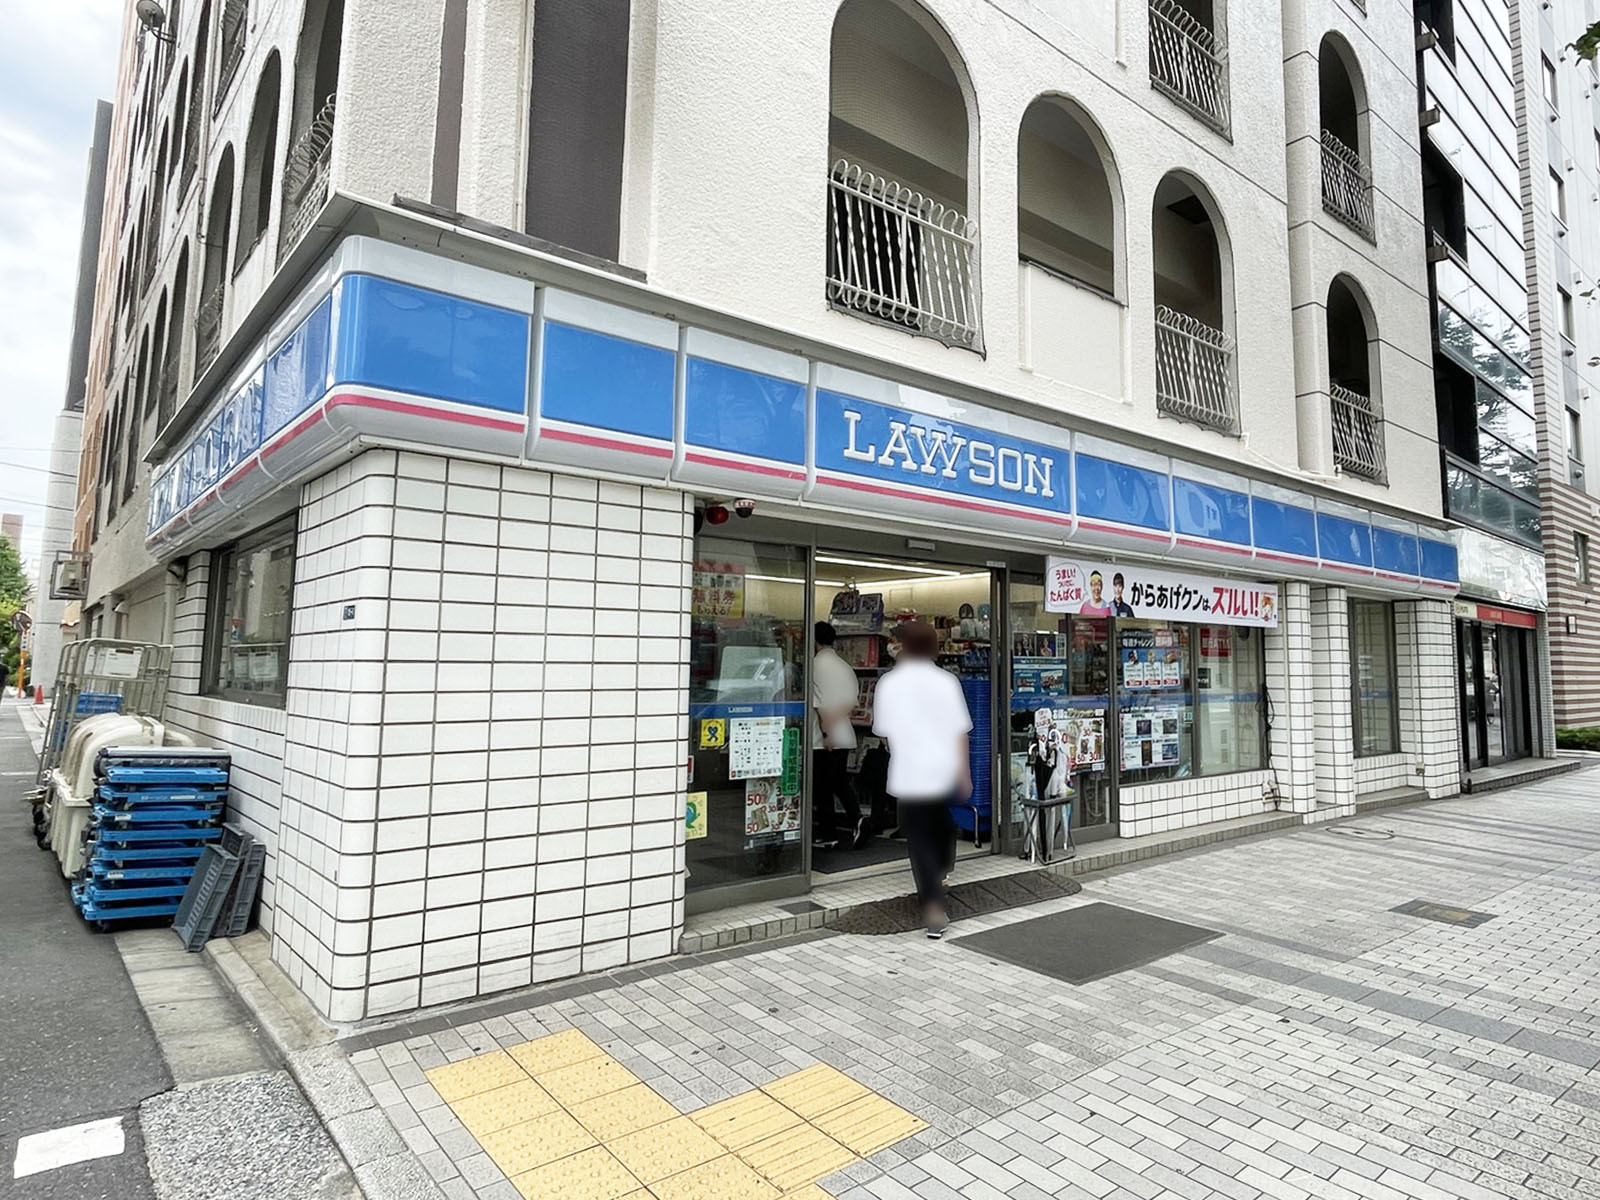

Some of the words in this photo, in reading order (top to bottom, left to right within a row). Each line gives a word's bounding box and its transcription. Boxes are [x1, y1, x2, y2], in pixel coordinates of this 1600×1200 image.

[843, 410, 1055, 498] LAWSON
[1056, 568, 1076, 580] うまい!
